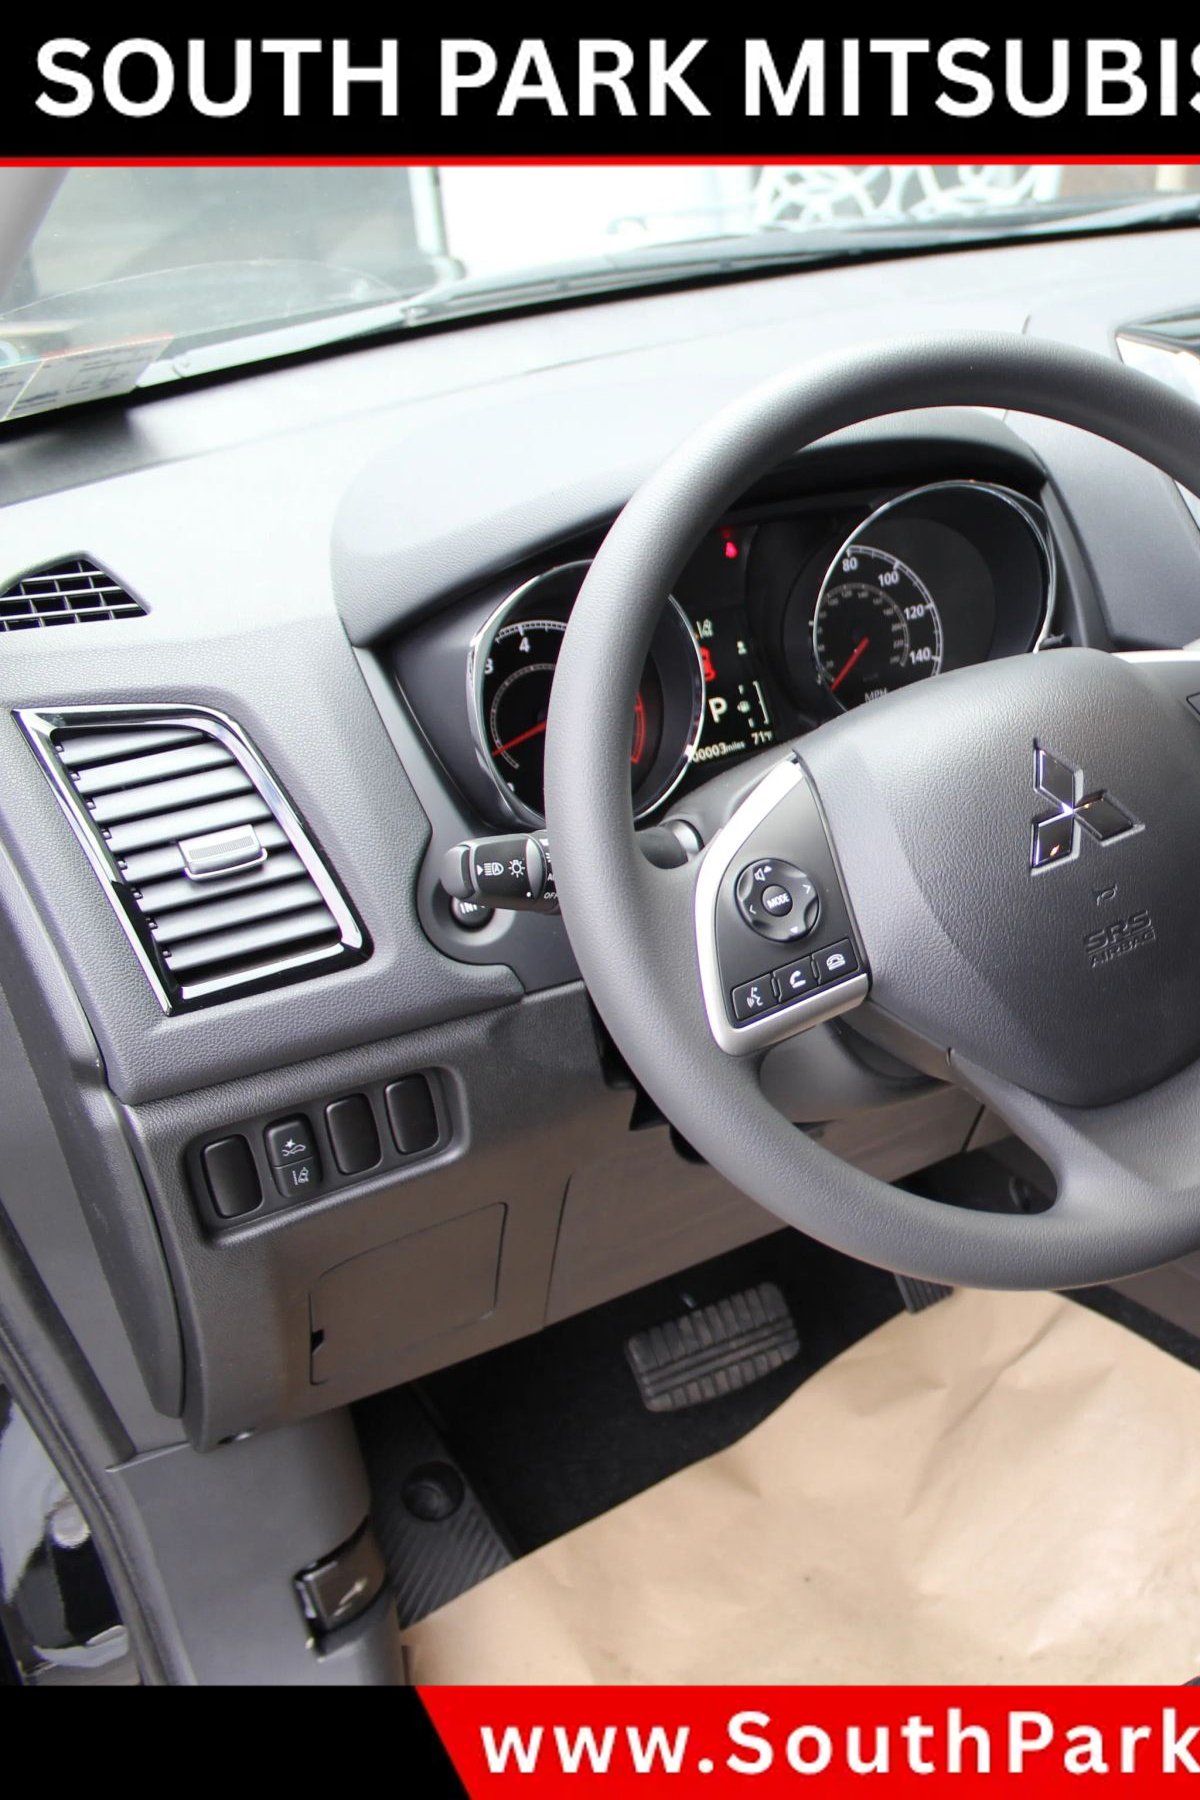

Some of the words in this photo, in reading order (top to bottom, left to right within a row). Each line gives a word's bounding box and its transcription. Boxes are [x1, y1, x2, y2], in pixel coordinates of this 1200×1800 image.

[842, 557, 858, 571] 80
[878, 572, 899, 586] 100
[904, 605, 925, 620] 120
[519, 637, 530, 653] 4
[909, 647, 931, 664] 140
[708, 696, 728, 723] P
[766, 892, 790, 909] MODE
[1085, 909, 1152, 955] SRS
